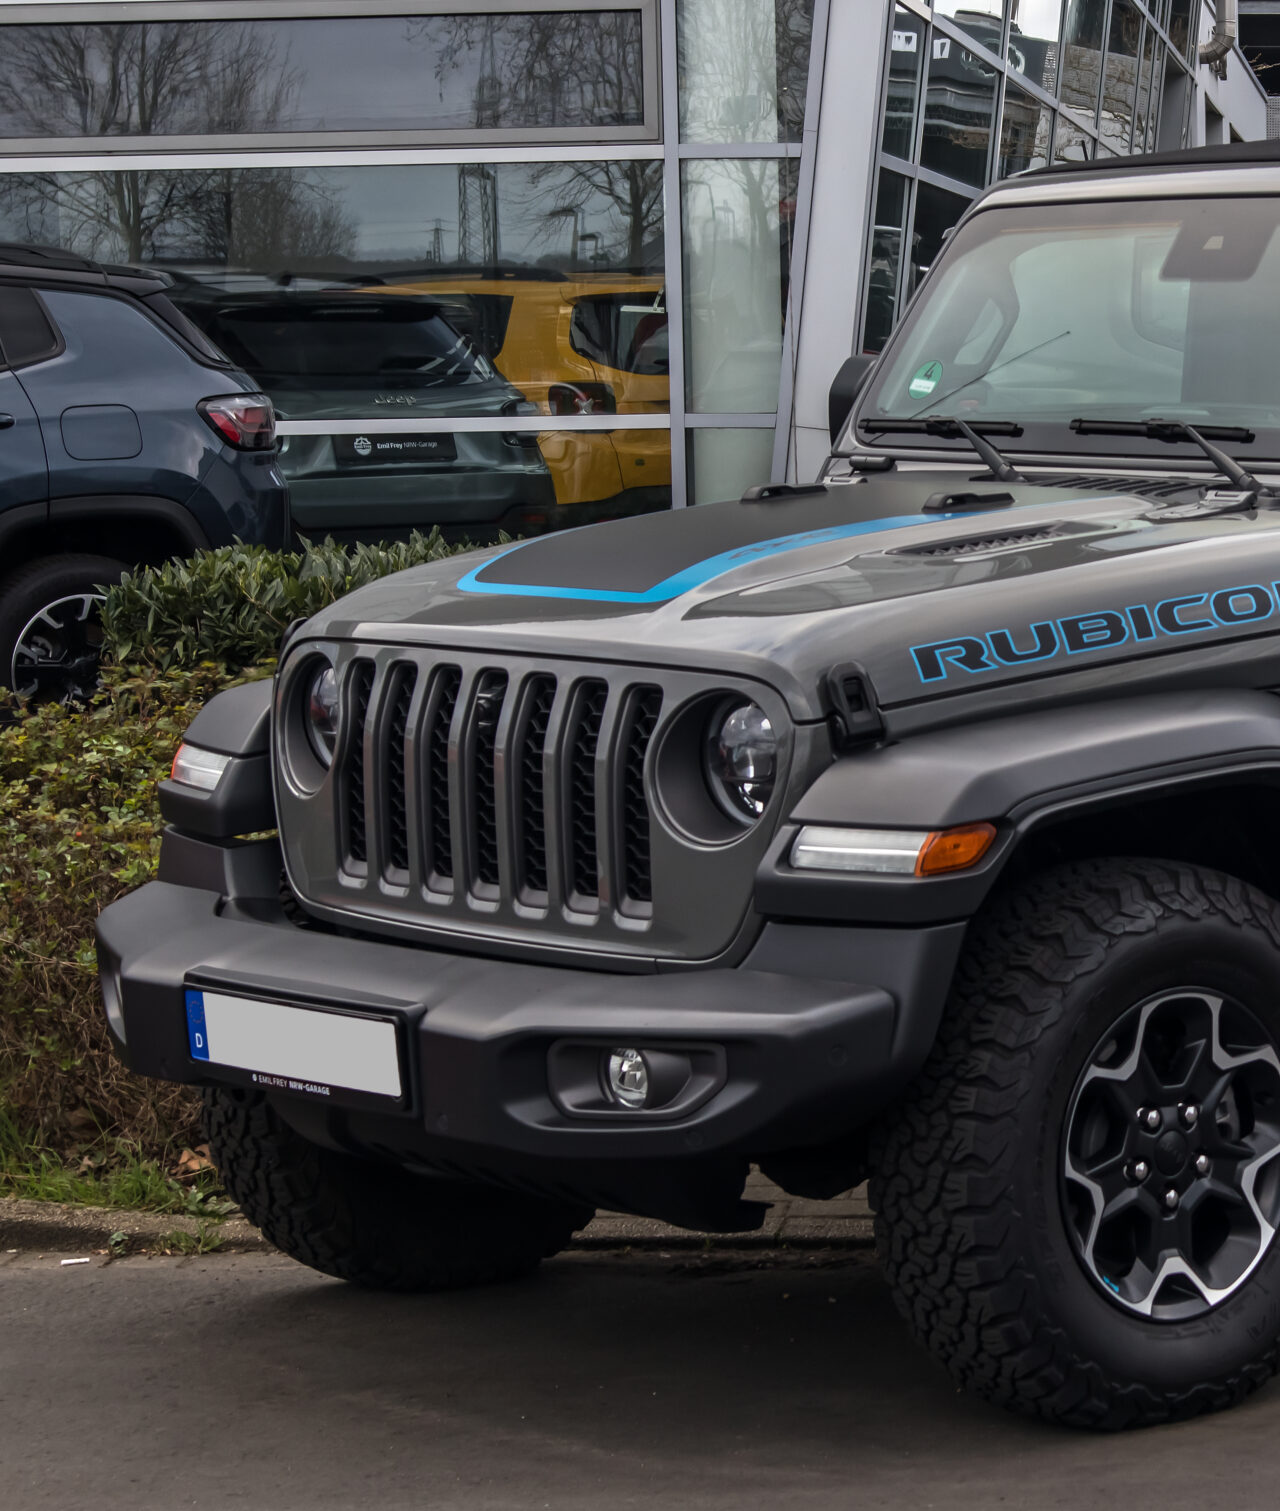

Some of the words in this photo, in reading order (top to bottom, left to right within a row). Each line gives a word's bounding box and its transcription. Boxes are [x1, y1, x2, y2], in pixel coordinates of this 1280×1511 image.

[924, 361, 937, 380] 4
[374, 392, 417, 406] Jeep
[195, 1032, 203, 1048] D
[289, 1080, 330, 1096] NRW-GARAGE
